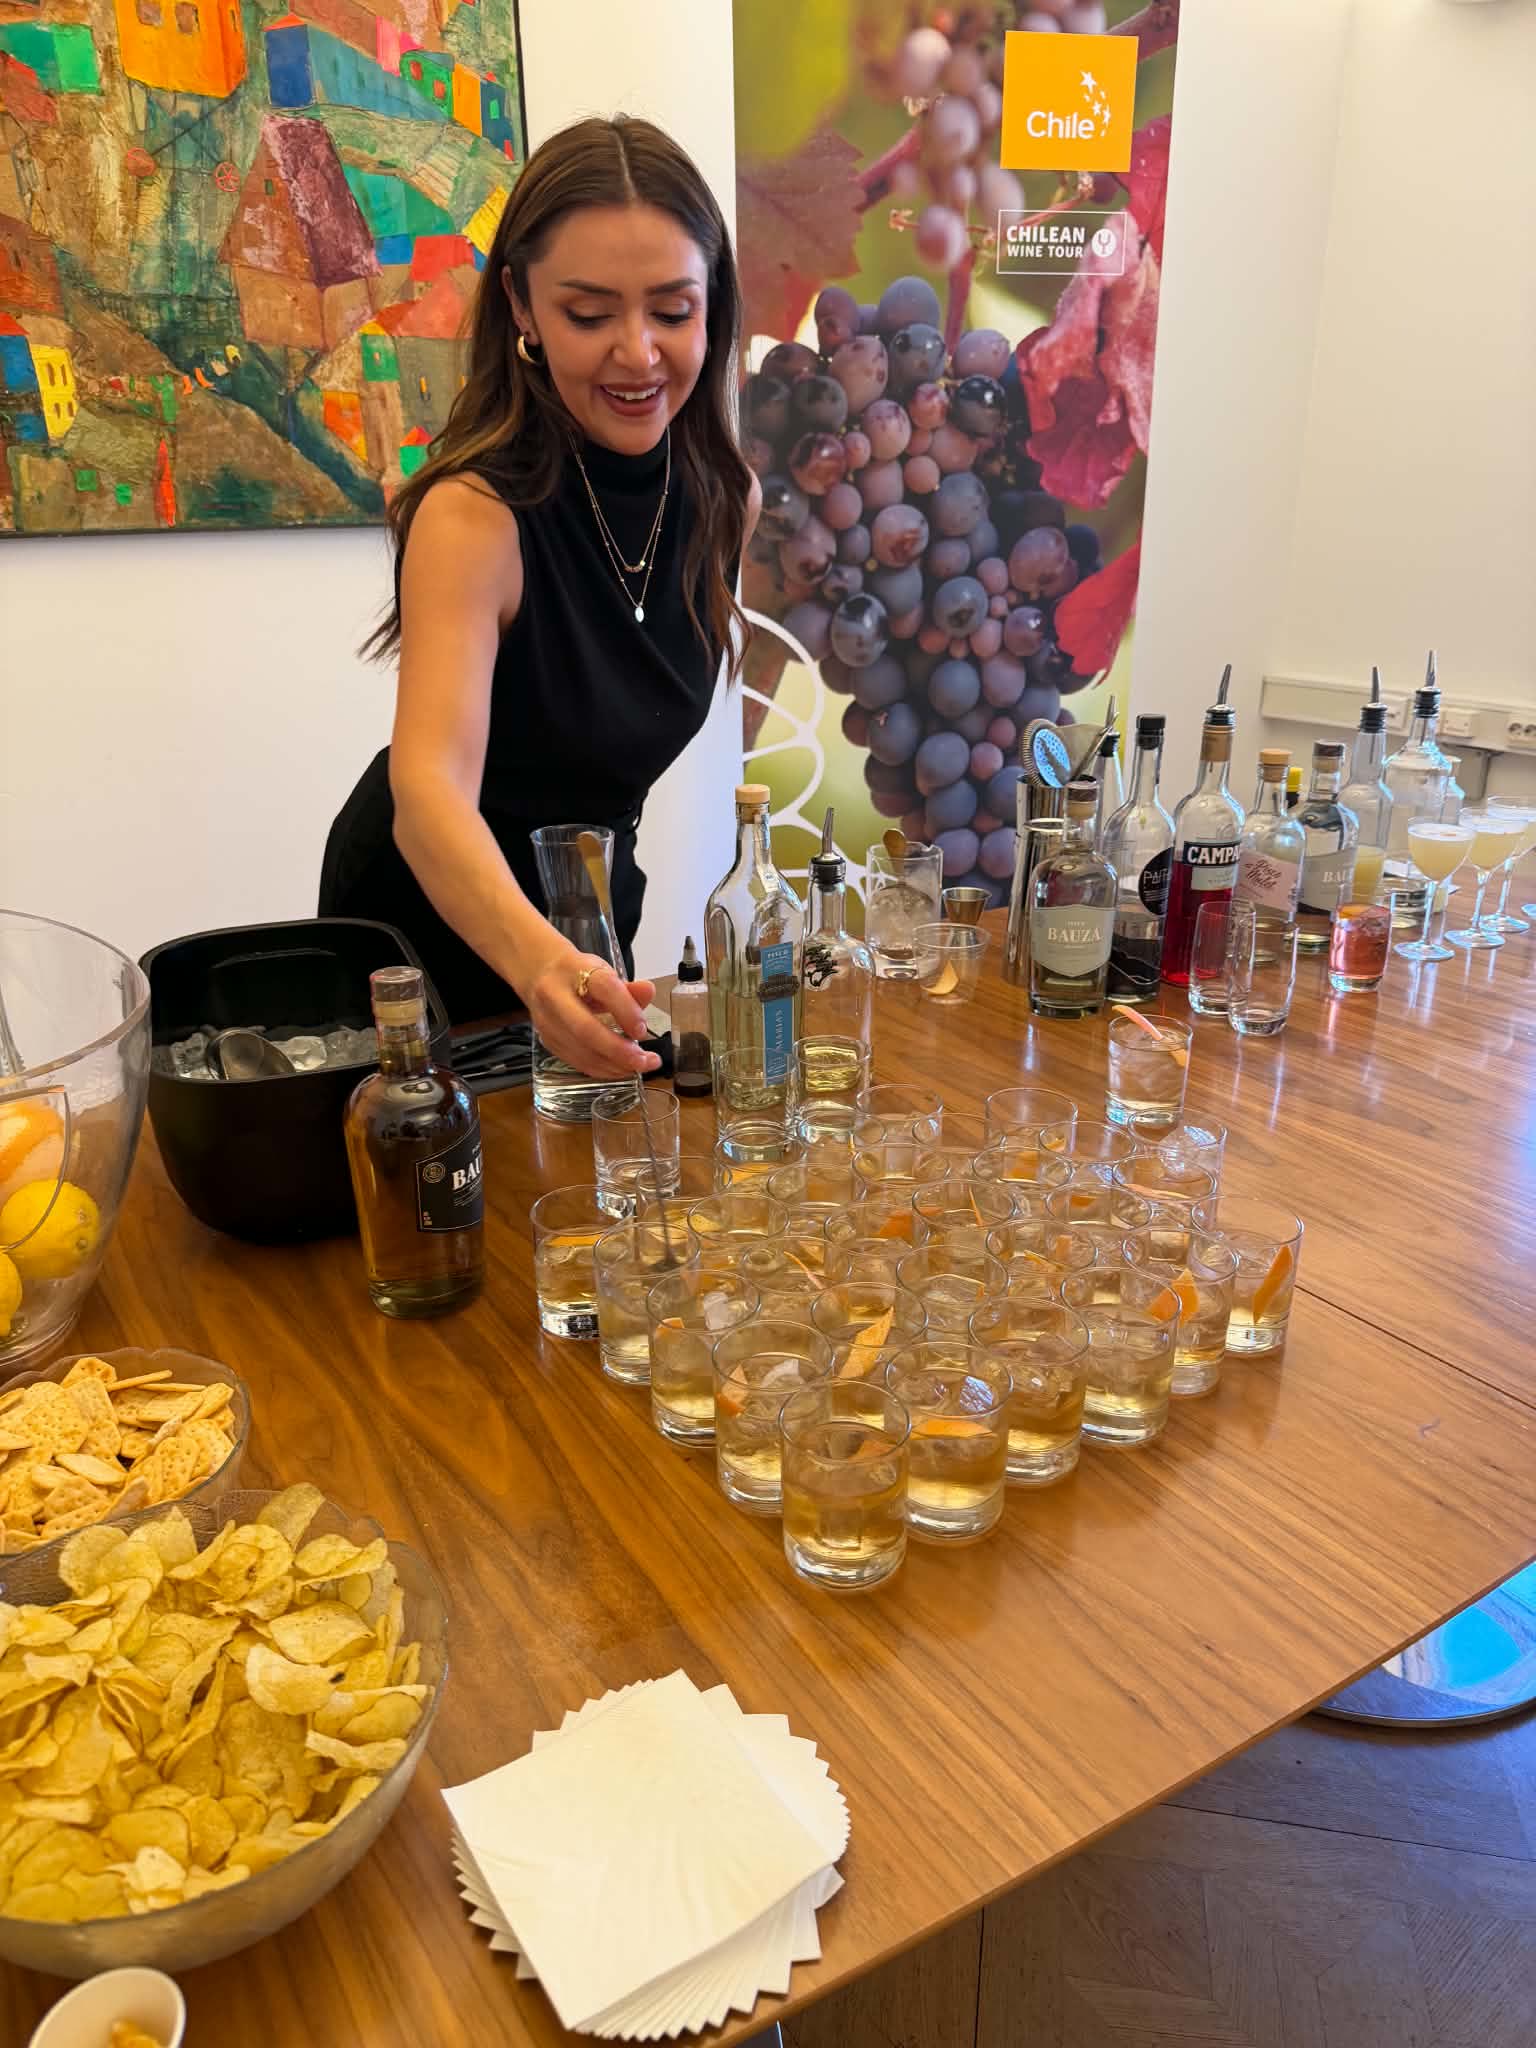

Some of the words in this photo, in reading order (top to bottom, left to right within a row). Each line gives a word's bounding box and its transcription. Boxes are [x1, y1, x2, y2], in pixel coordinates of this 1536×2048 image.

[1026, 110, 1095, 139] Chile
[1006, 225, 1085, 244] CHILEAN
[1007, 244, 1043, 258] WINE
[1047, 245, 1083, 258] TOUR
